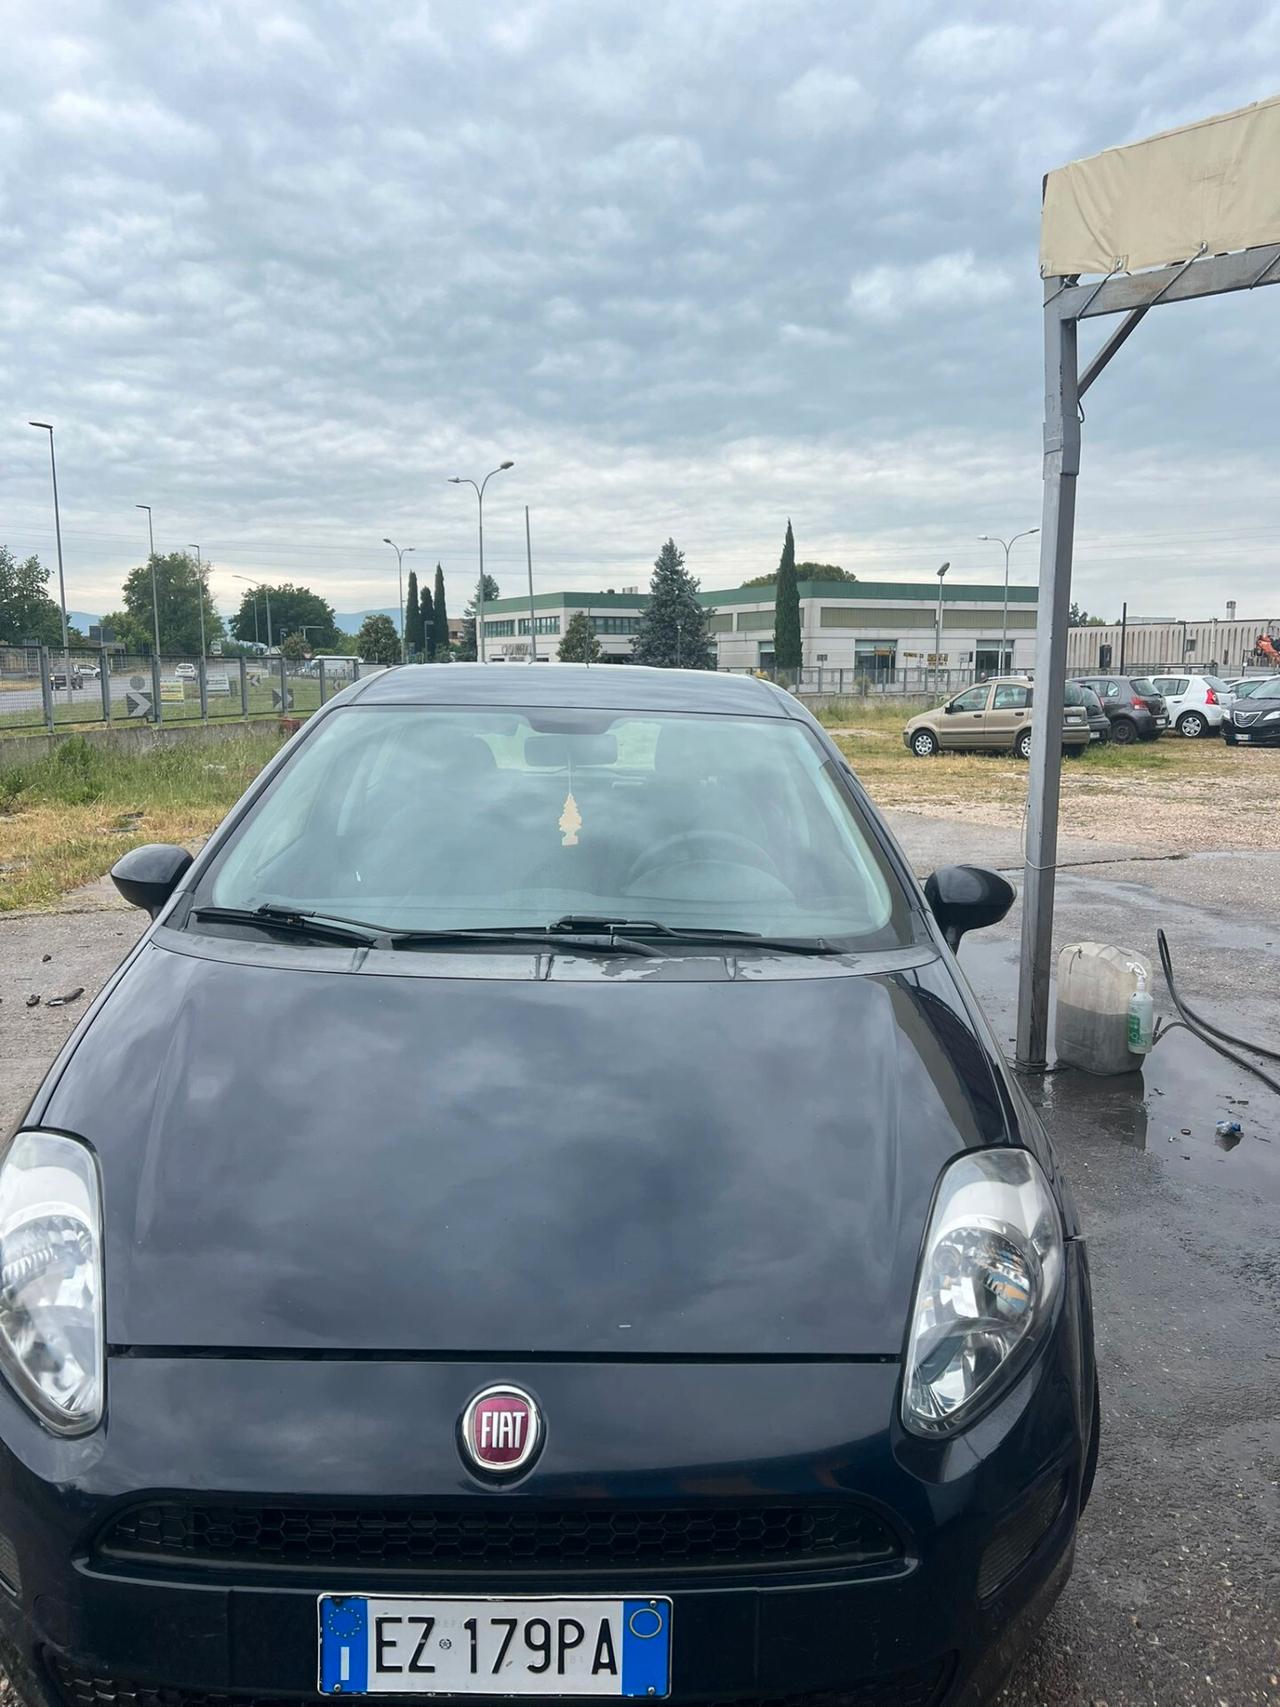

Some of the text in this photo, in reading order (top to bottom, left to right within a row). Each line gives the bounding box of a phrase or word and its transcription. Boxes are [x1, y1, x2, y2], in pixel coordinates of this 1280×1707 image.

[481, 1411, 526, 1449] FIAT
[375, 1616, 617, 1674] EZ 179PA
